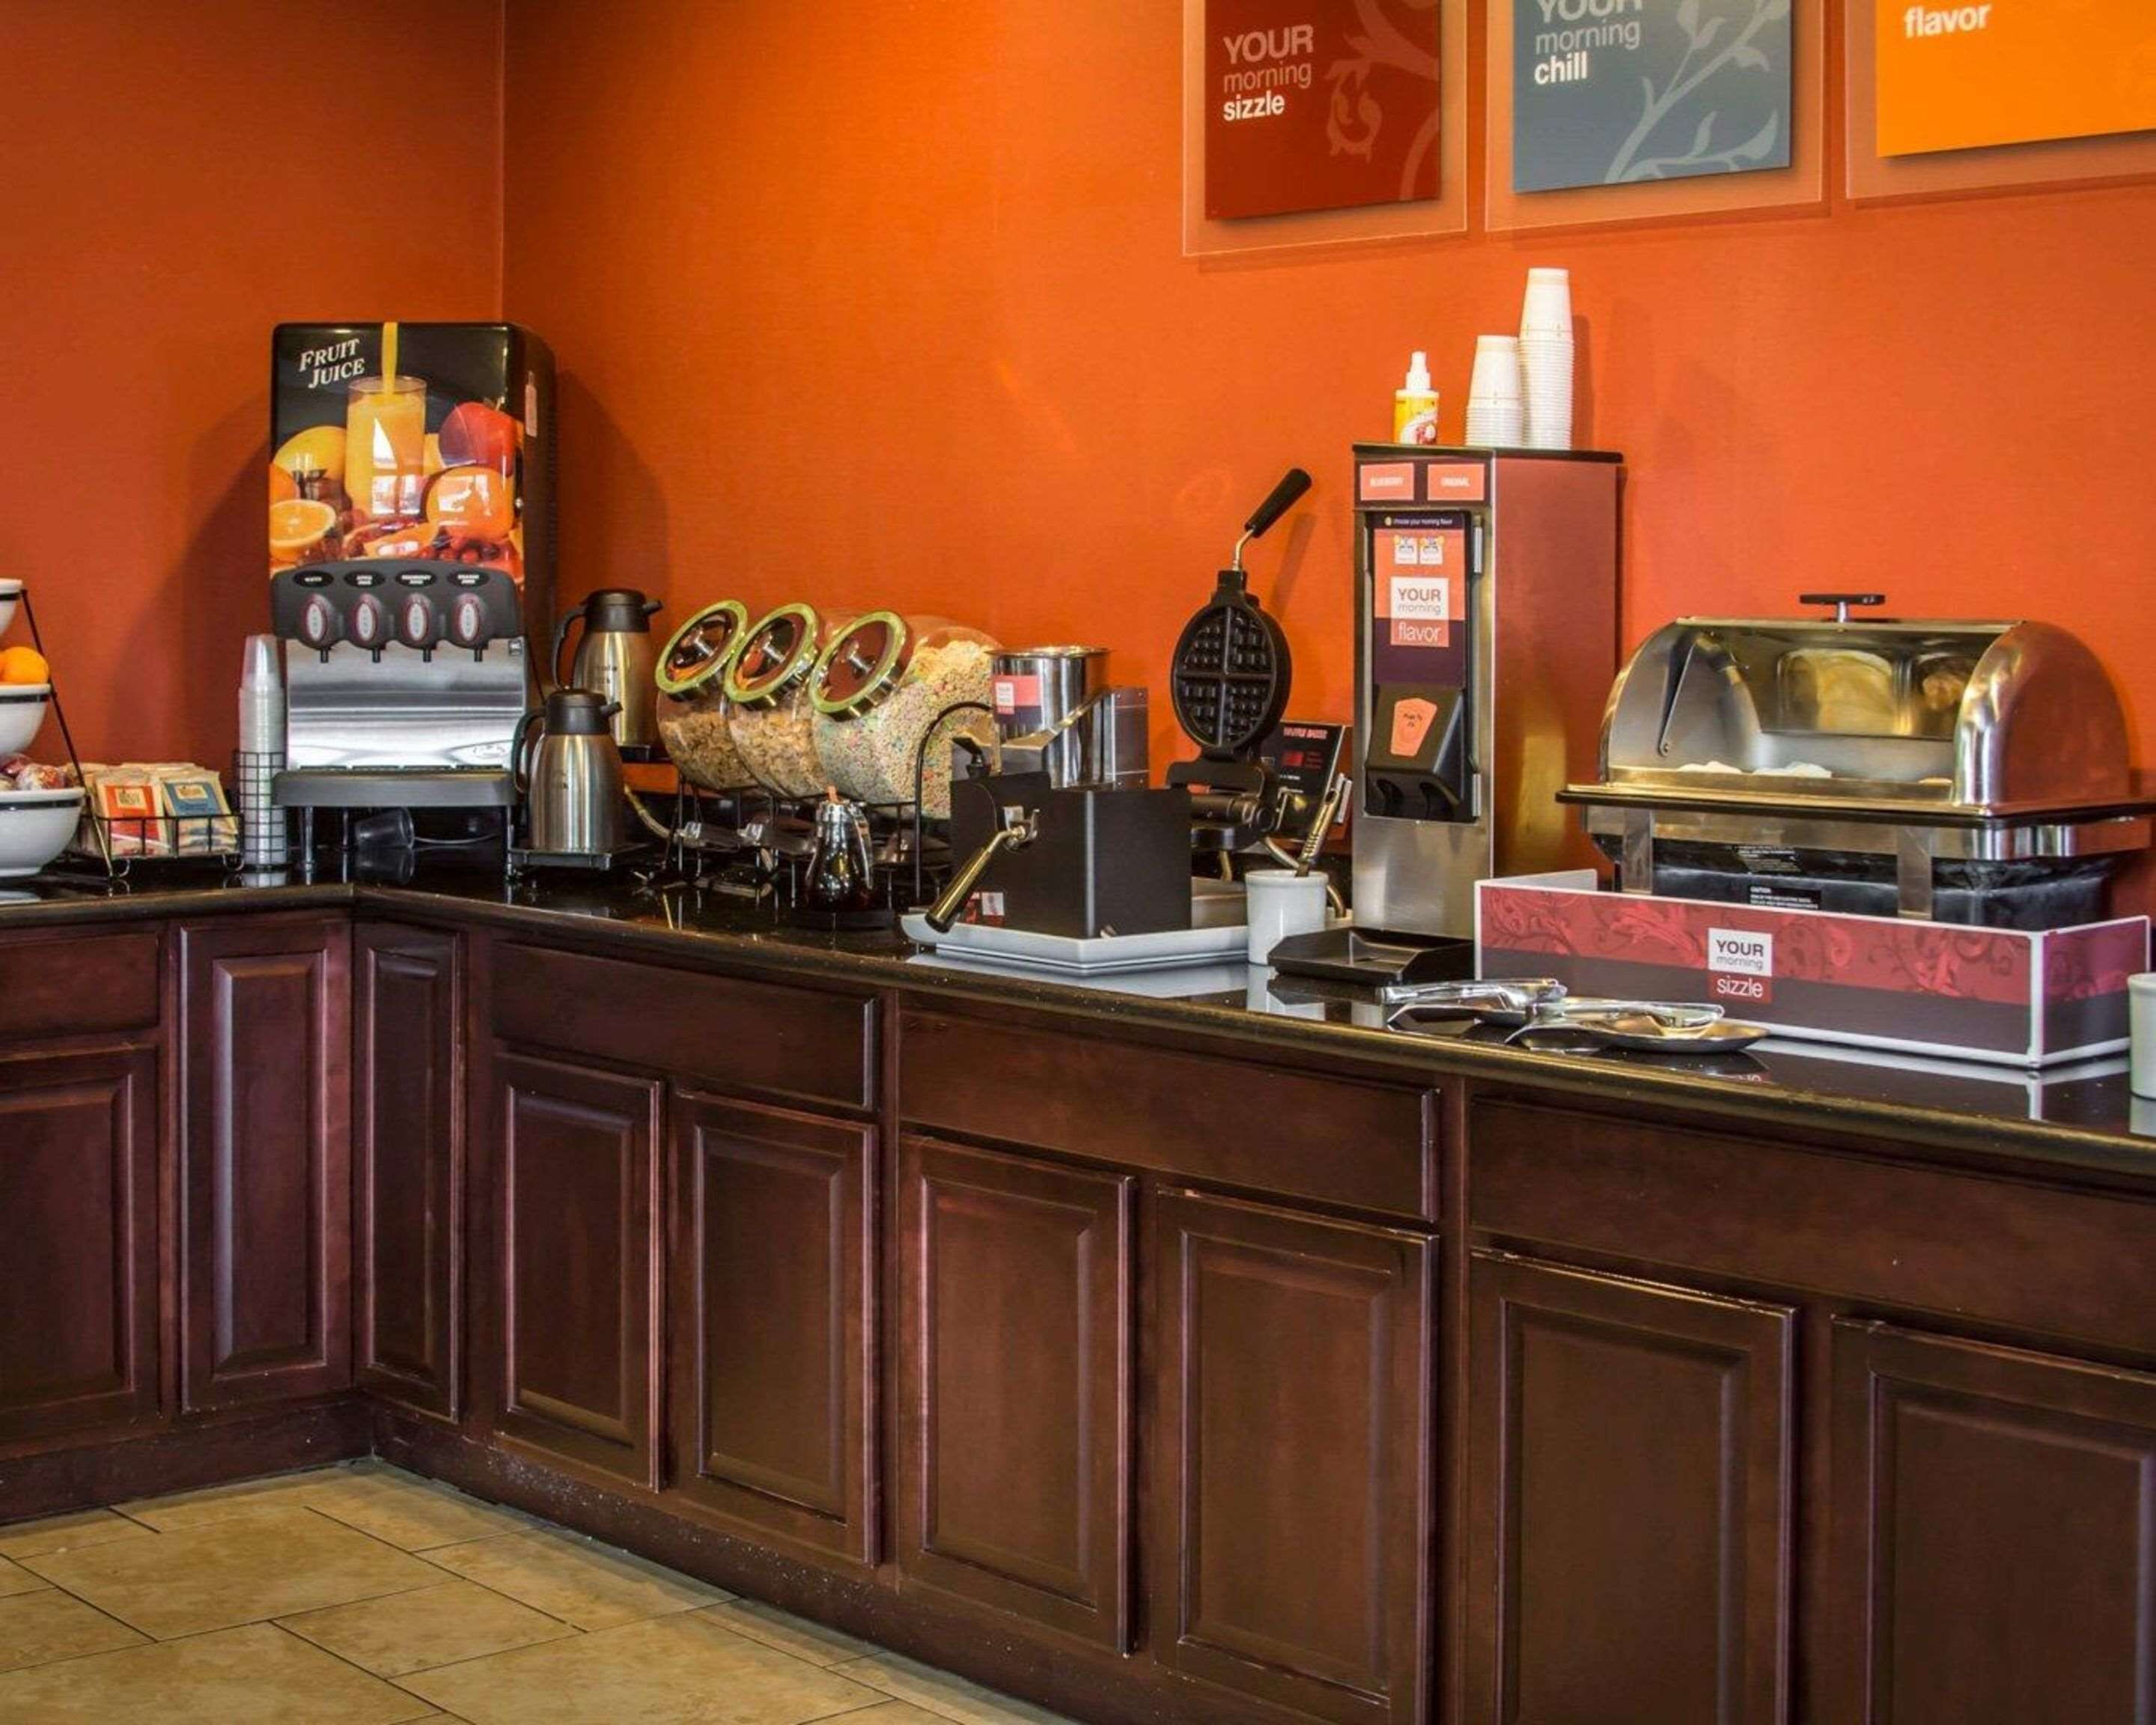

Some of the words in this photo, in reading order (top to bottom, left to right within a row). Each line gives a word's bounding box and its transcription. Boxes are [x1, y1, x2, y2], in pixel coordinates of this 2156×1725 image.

[1535, 18, 1640, 55] morning
[1904, 4, 1991, 38] flavor
[1223, 24, 1314, 64] YOUR
[1224, 61, 1312, 93] morning
[1535, 51, 1587, 85] chill
[1223, 90, 1285, 121] sizzle
[299, 338, 359, 372] FRUIT
[308, 358, 365, 389] JUICE
[1398, 588, 1441, 601] YOUR
[1398, 602, 1441, 615] morning
[1398, 621, 1441, 642] flavor
[1717, 940, 1764, 957] YOUR
[1717, 956, 1763, 970] morning
[1717, 975, 1763, 998] sizzle
